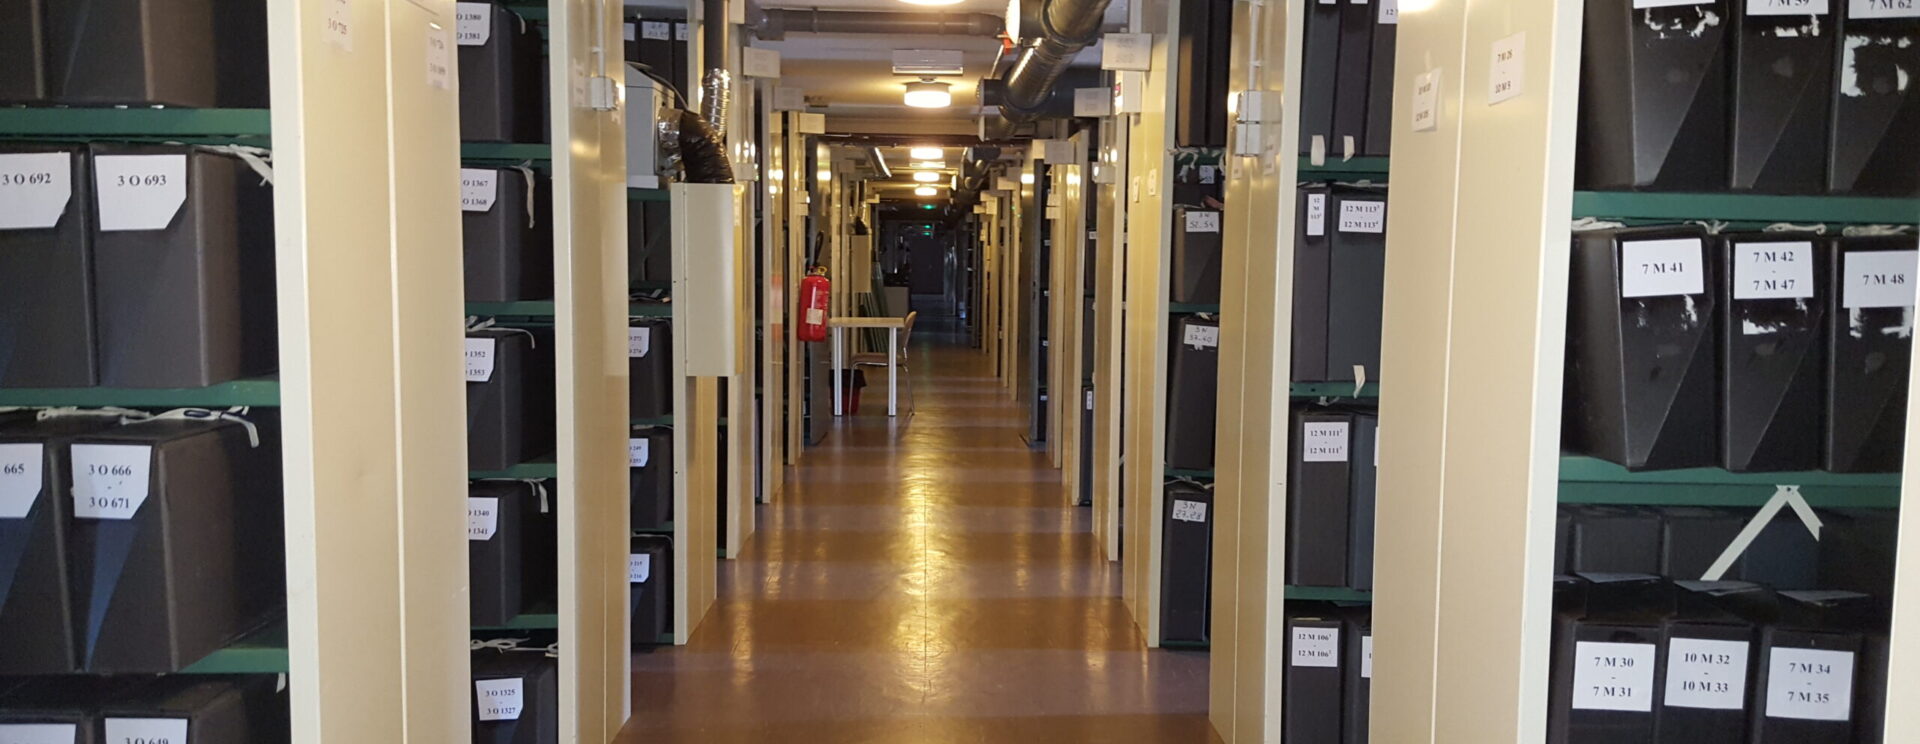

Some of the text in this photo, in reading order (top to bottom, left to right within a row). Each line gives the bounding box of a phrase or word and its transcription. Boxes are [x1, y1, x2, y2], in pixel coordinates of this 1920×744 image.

[1870, 0, 1912, 10] 7 M 62
[1386, 8, 1394, 16] 12
[2, 172, 52, 185] 3 O 692
[117, 174, 167, 187] 3 O 693
[472, 198, 488, 206] 1368
[1753, 252, 1795, 263] 7 M 42
[1642, 262, 1684, 274] 7 M 41
[1753, 279, 1795, 291] 7 M 47
[1863, 273, 1905, 285] 7 M 48
[470, 350, 486, 358] 1352
[4, 463, 25, 475] 665
[88, 464, 132, 476] 3 O 666
[88, 496, 130, 509] 3 O 671
[1594, 656, 1634, 668] 7 M 30
[1684, 652, 1730, 665] 10 M 32
[1789, 662, 1831, 674] 7 M 34
[500, 688, 516, 697] 1325
[1593, 686, 1632, 698] 7 M 31
[1682, 681, 1729, 693] 10 M 33
[1788, 691, 1830, 704] 7 M 35
